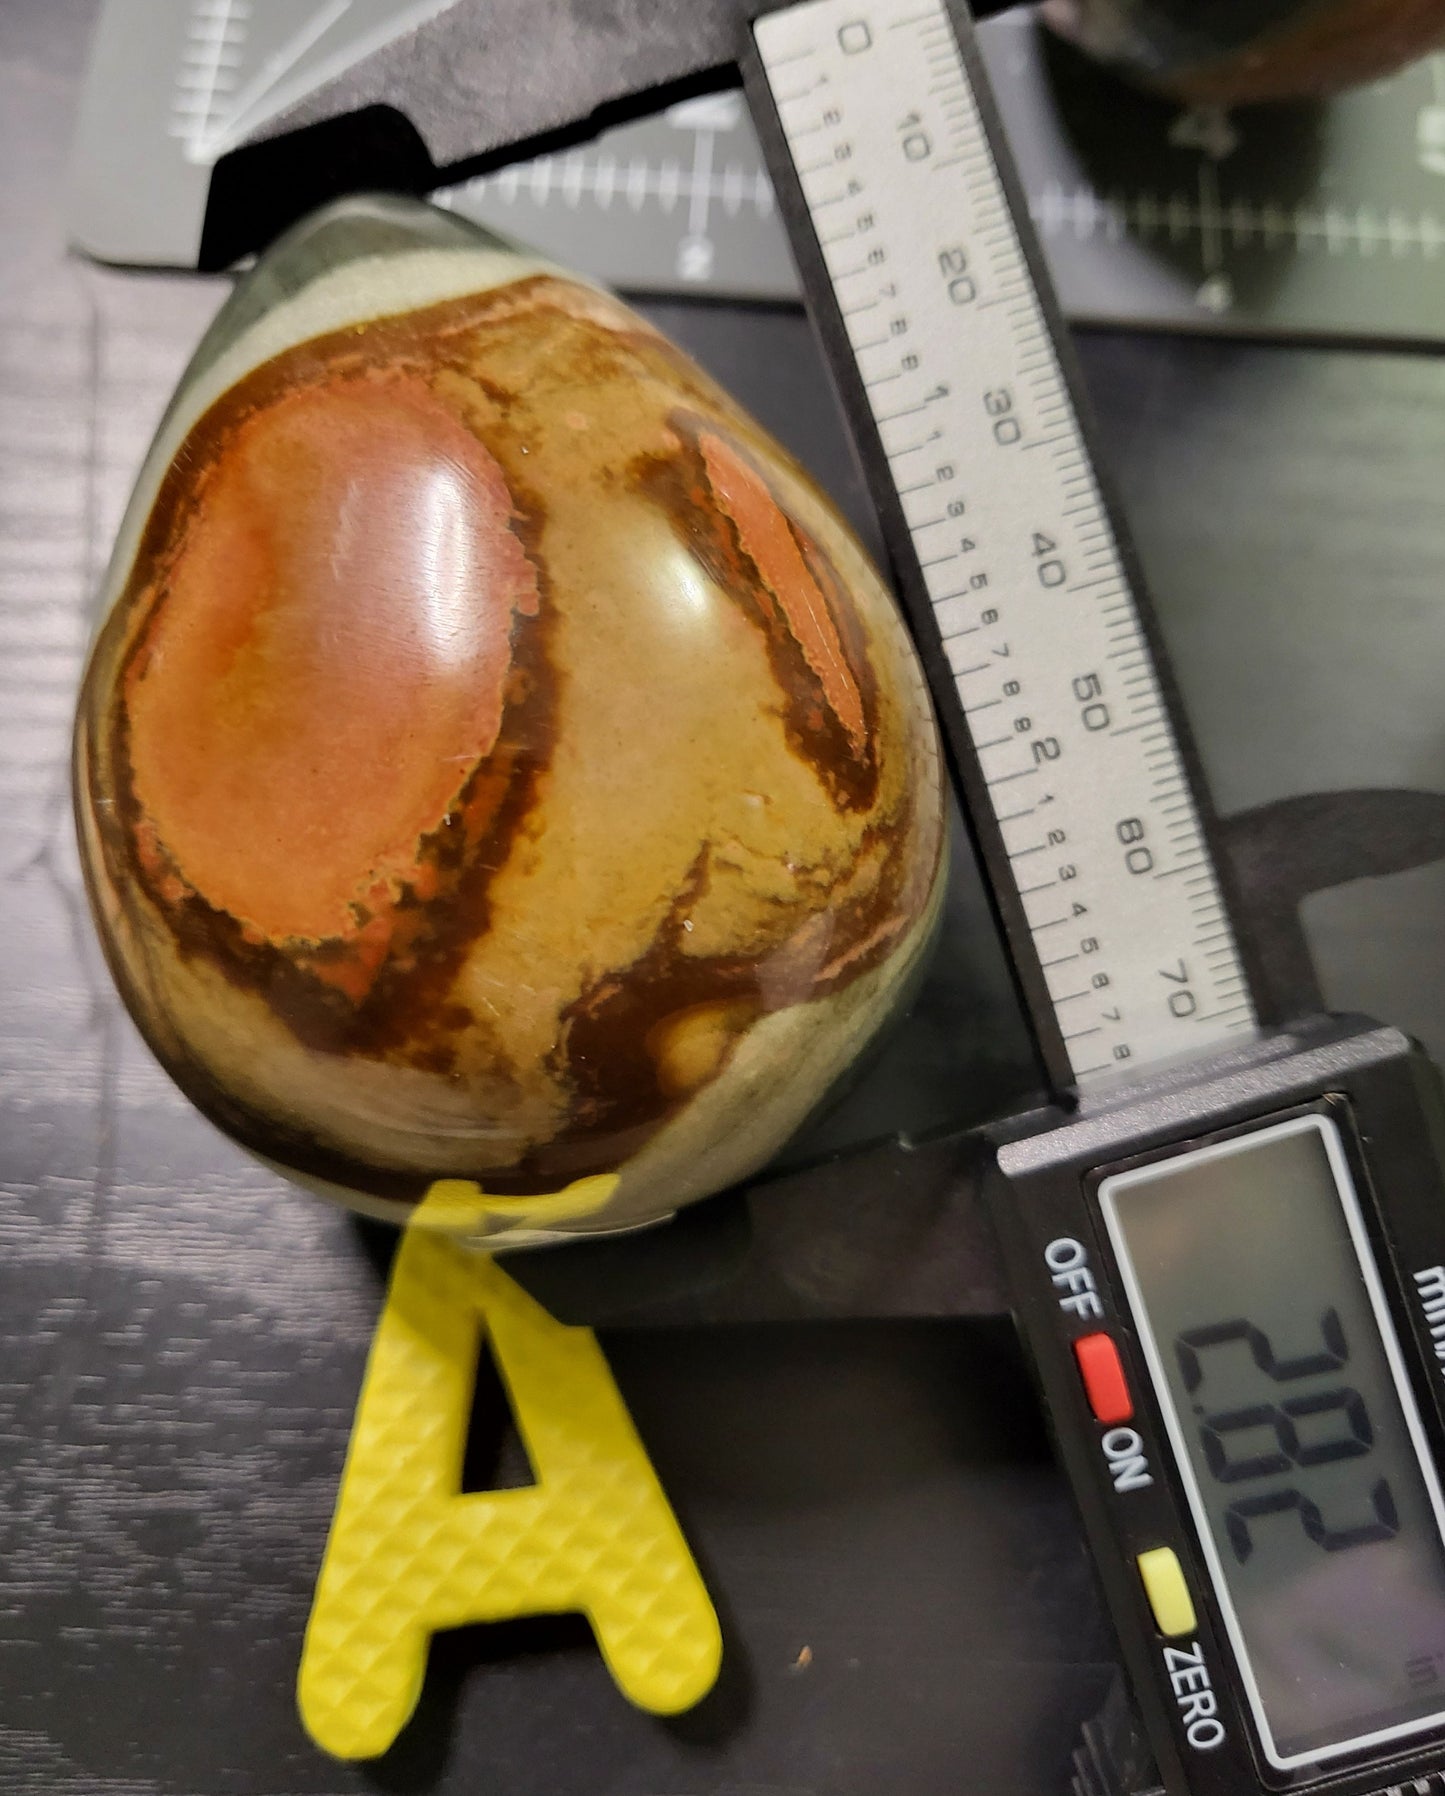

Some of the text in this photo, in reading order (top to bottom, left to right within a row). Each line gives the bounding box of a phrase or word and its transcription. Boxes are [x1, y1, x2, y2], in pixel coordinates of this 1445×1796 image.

[838, 20, 872, 55] 0
[898, 110, 930, 162] 10
[937, 247, 976, 305] 20
[983, 388, 1021, 446] 30
[1031, 532, 1066, 588] 40
[1072, 672, 1110, 732] 50
[1158, 958, 1196, 1018] 70
[924, 384, 950, 403] 1
[947, 500, 965, 518] 3
[960, 537, 976, 553] 4
[969, 573, 989, 590] 5
[991, 643, 1010, 658] 7
[1031, 737, 1061, 763] 2
[1047, 828, 1066, 847] 2
[1058, 864, 1077, 882] 3
[1071, 902, 1088, 918] 4
[1080, 936, 1100, 955] 5
[1101, 1007, 1121, 1022] 7
[1044, 1237, 1103, 1321] OFF
[297, 1228, 722, 1761] A
[1101, 1426, 1154, 1493] ON
[1174, 1305, 1400, 1566] 2.82
[1163, 1641, 1227, 1751] ZERO
